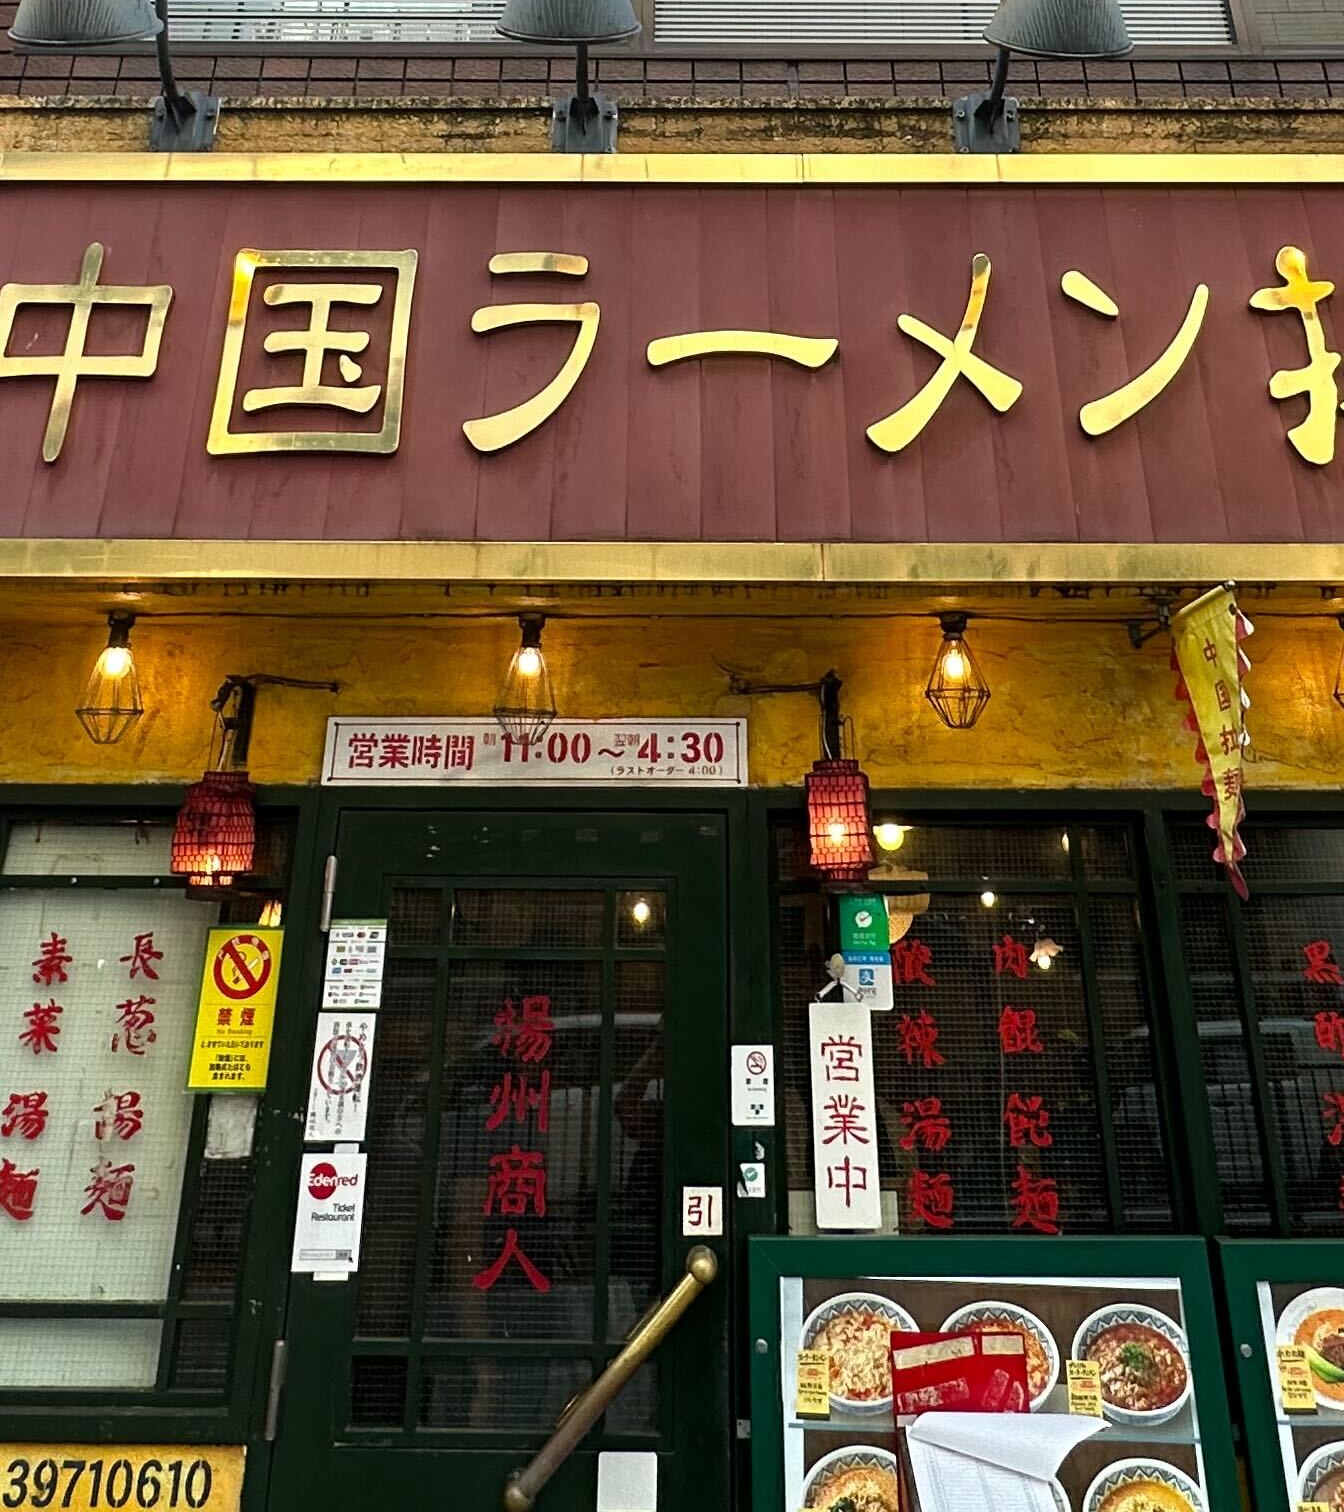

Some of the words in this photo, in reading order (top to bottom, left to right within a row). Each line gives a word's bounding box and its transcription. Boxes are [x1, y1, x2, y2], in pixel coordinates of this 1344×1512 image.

[347, 733, 475, 771] 営業時間
[216, 1006, 256, 1027] 禁煙
[820, 1034, 871, 1209] 営業中
[307, 1172, 359, 1187] Edenred
[687, 1195, 713, 1228] 引
